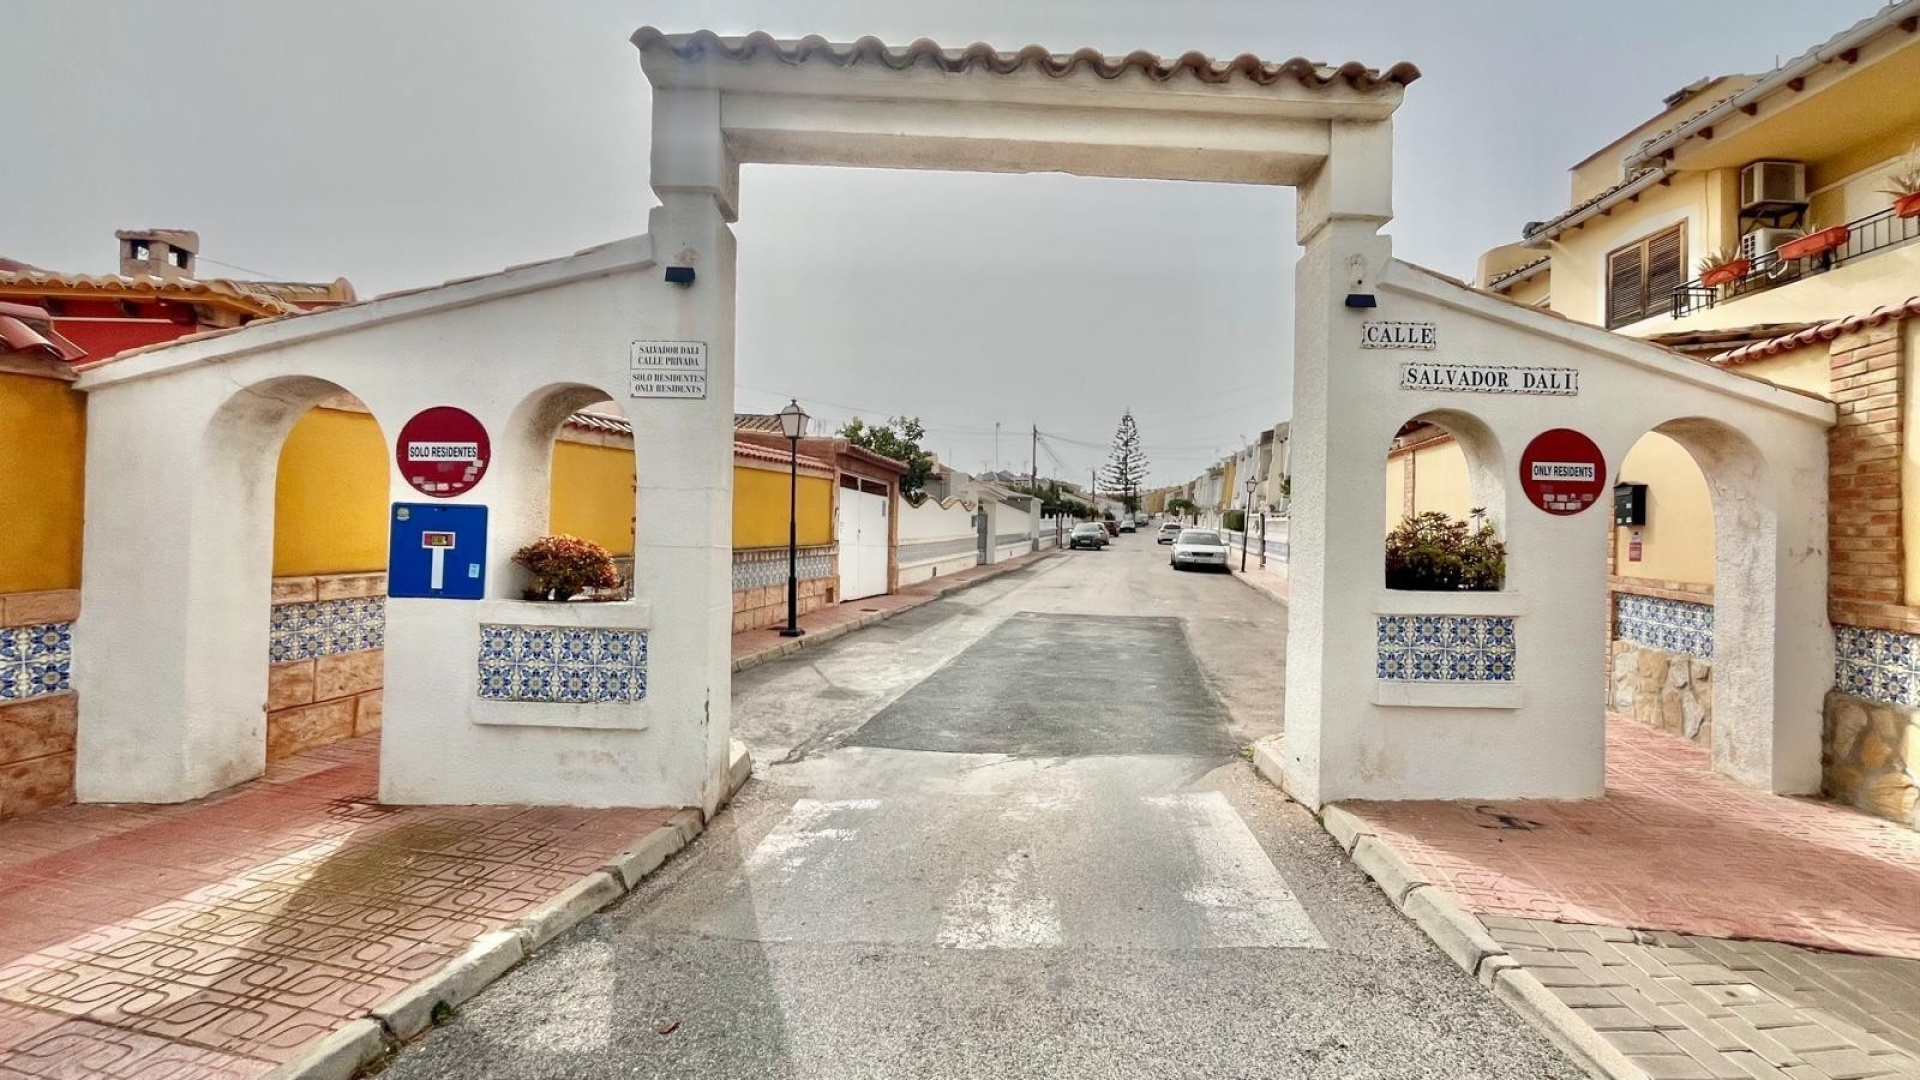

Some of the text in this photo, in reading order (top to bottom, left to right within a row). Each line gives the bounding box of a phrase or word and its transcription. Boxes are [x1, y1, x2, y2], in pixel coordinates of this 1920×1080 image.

[1367, 326, 1433, 344] CALLE
[639, 346, 679, 354] SALVADOR
[637, 356, 700, 366] CALLE PRIVADA
[632, 373, 705, 383] SOLO RESIDENTES
[1407, 367, 1572, 390] SALVADOR DALI
[635, 384, 702, 393] ONLY RESIDENTS
[409, 446, 477, 458] SOLO RESIDENTES
[1533, 464, 1593, 478] ONLY RESIDENTS
